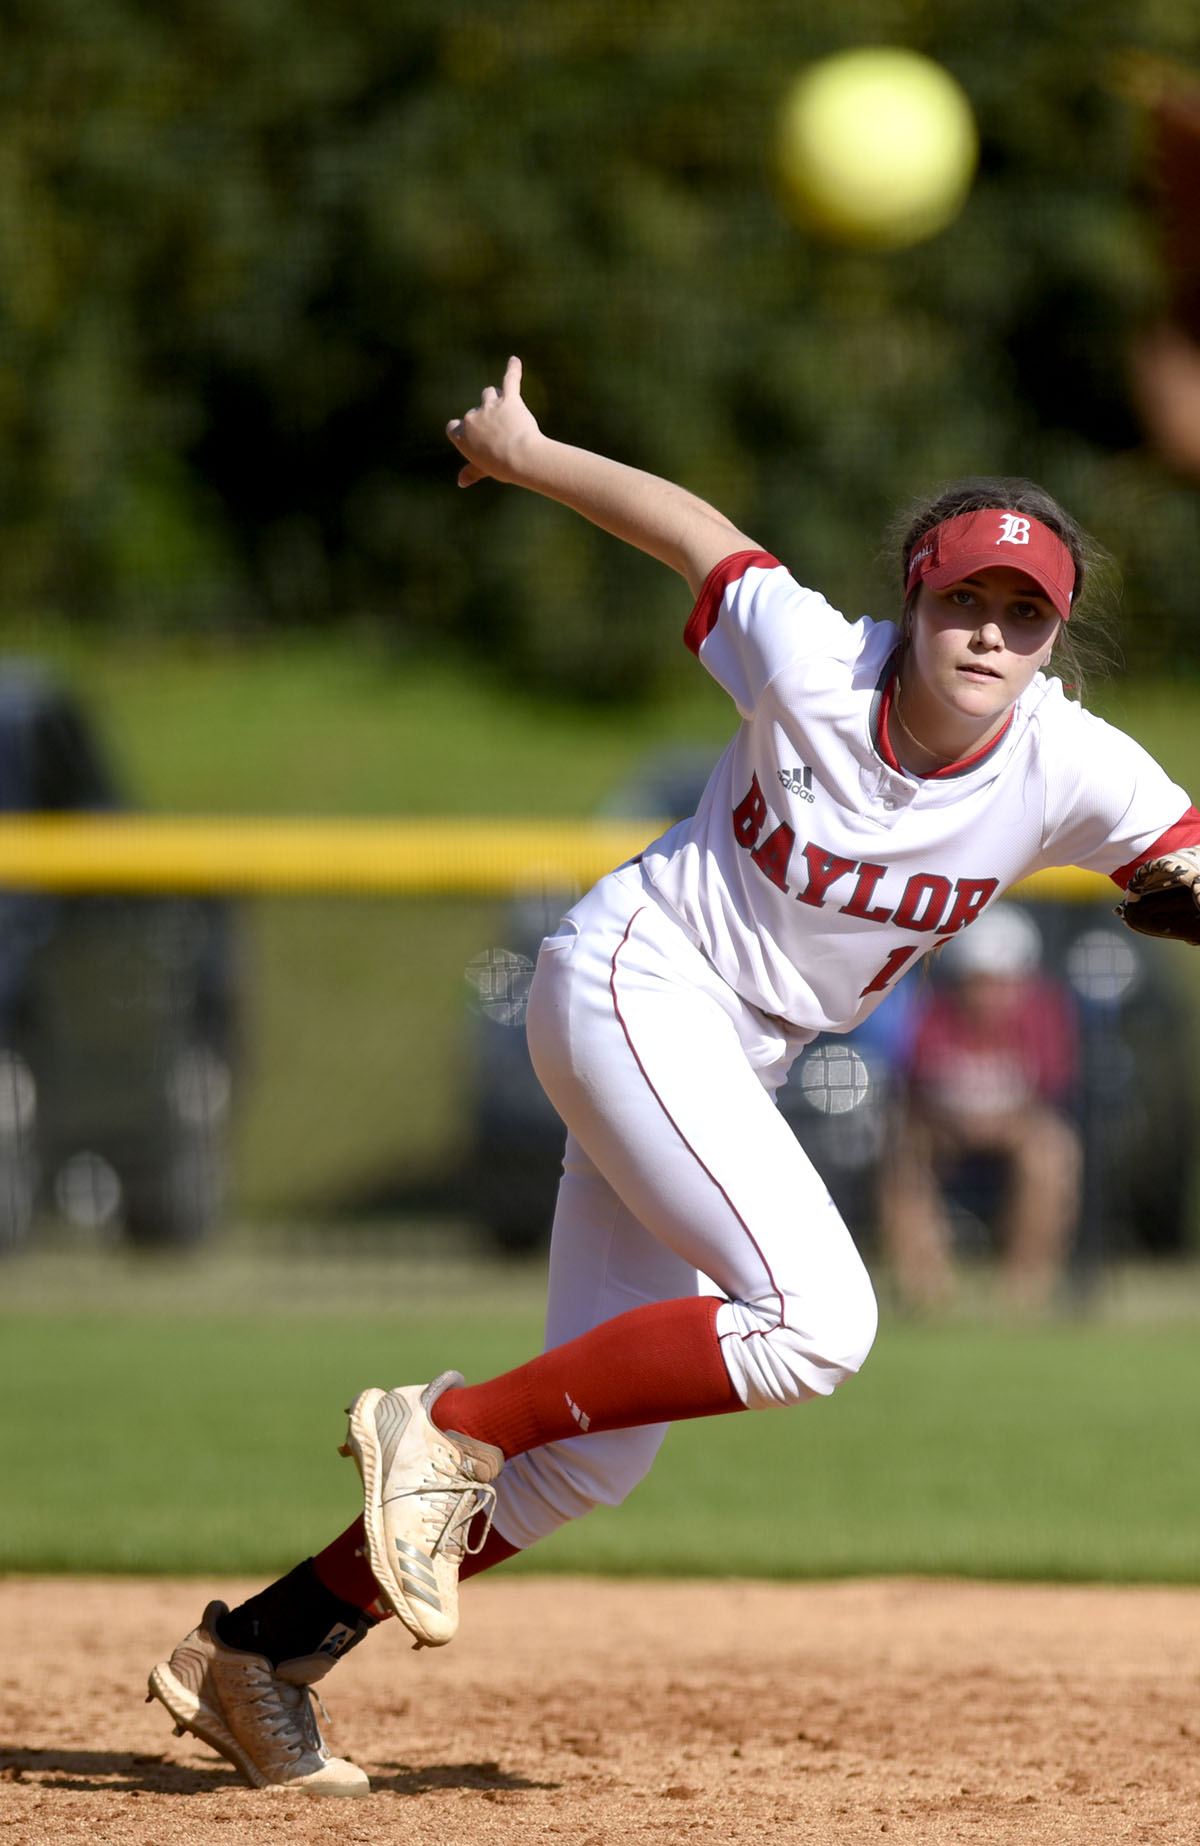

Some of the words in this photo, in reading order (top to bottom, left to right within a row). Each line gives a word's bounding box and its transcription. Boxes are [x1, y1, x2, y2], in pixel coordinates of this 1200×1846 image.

[996, 513, 1031, 545] B
[776, 770, 816, 804] adidas
[732, 769, 1000, 935] BAYLOR
